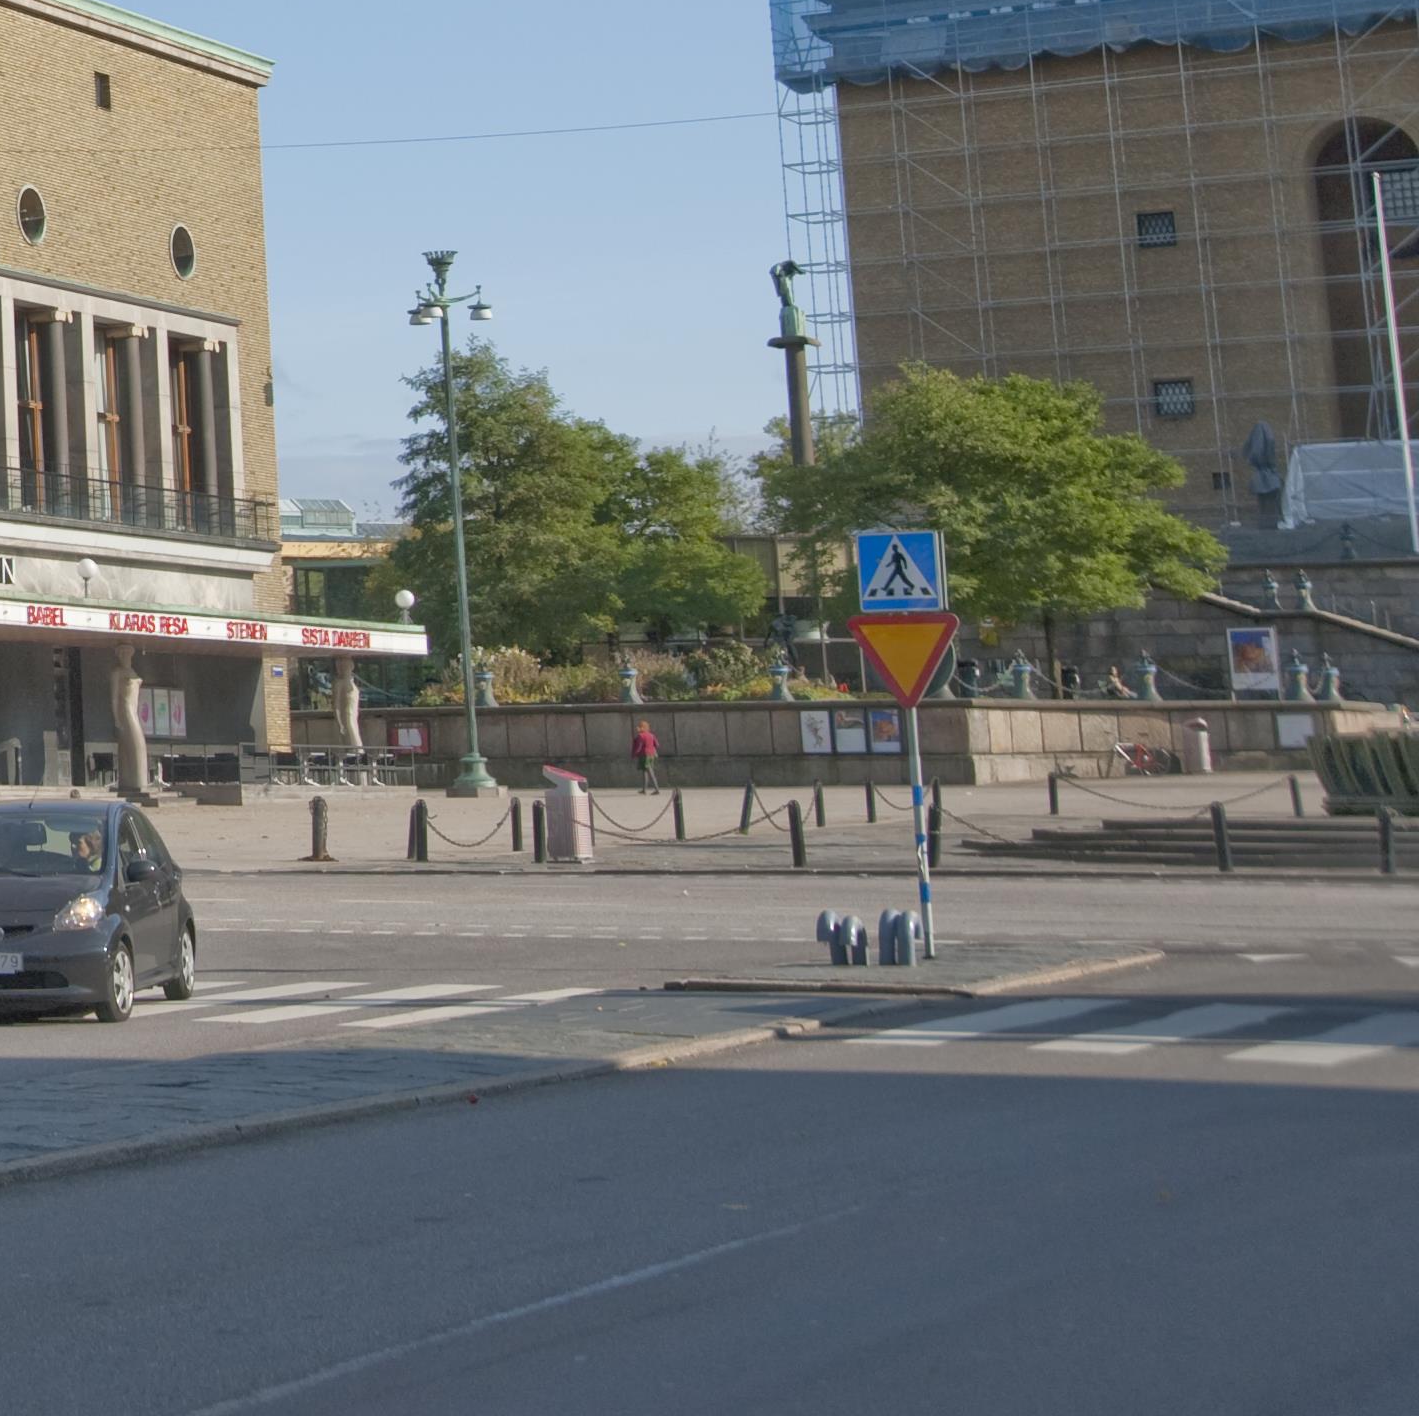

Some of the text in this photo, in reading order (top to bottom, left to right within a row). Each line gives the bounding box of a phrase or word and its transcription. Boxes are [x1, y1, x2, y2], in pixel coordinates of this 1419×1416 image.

[27, 605, 67, 627] BABEL
[108, 612, 156, 633] KLARAS
[226, 621, 268, 641] STENEN
[301, 627, 371, 649] SISTA DANSEN
